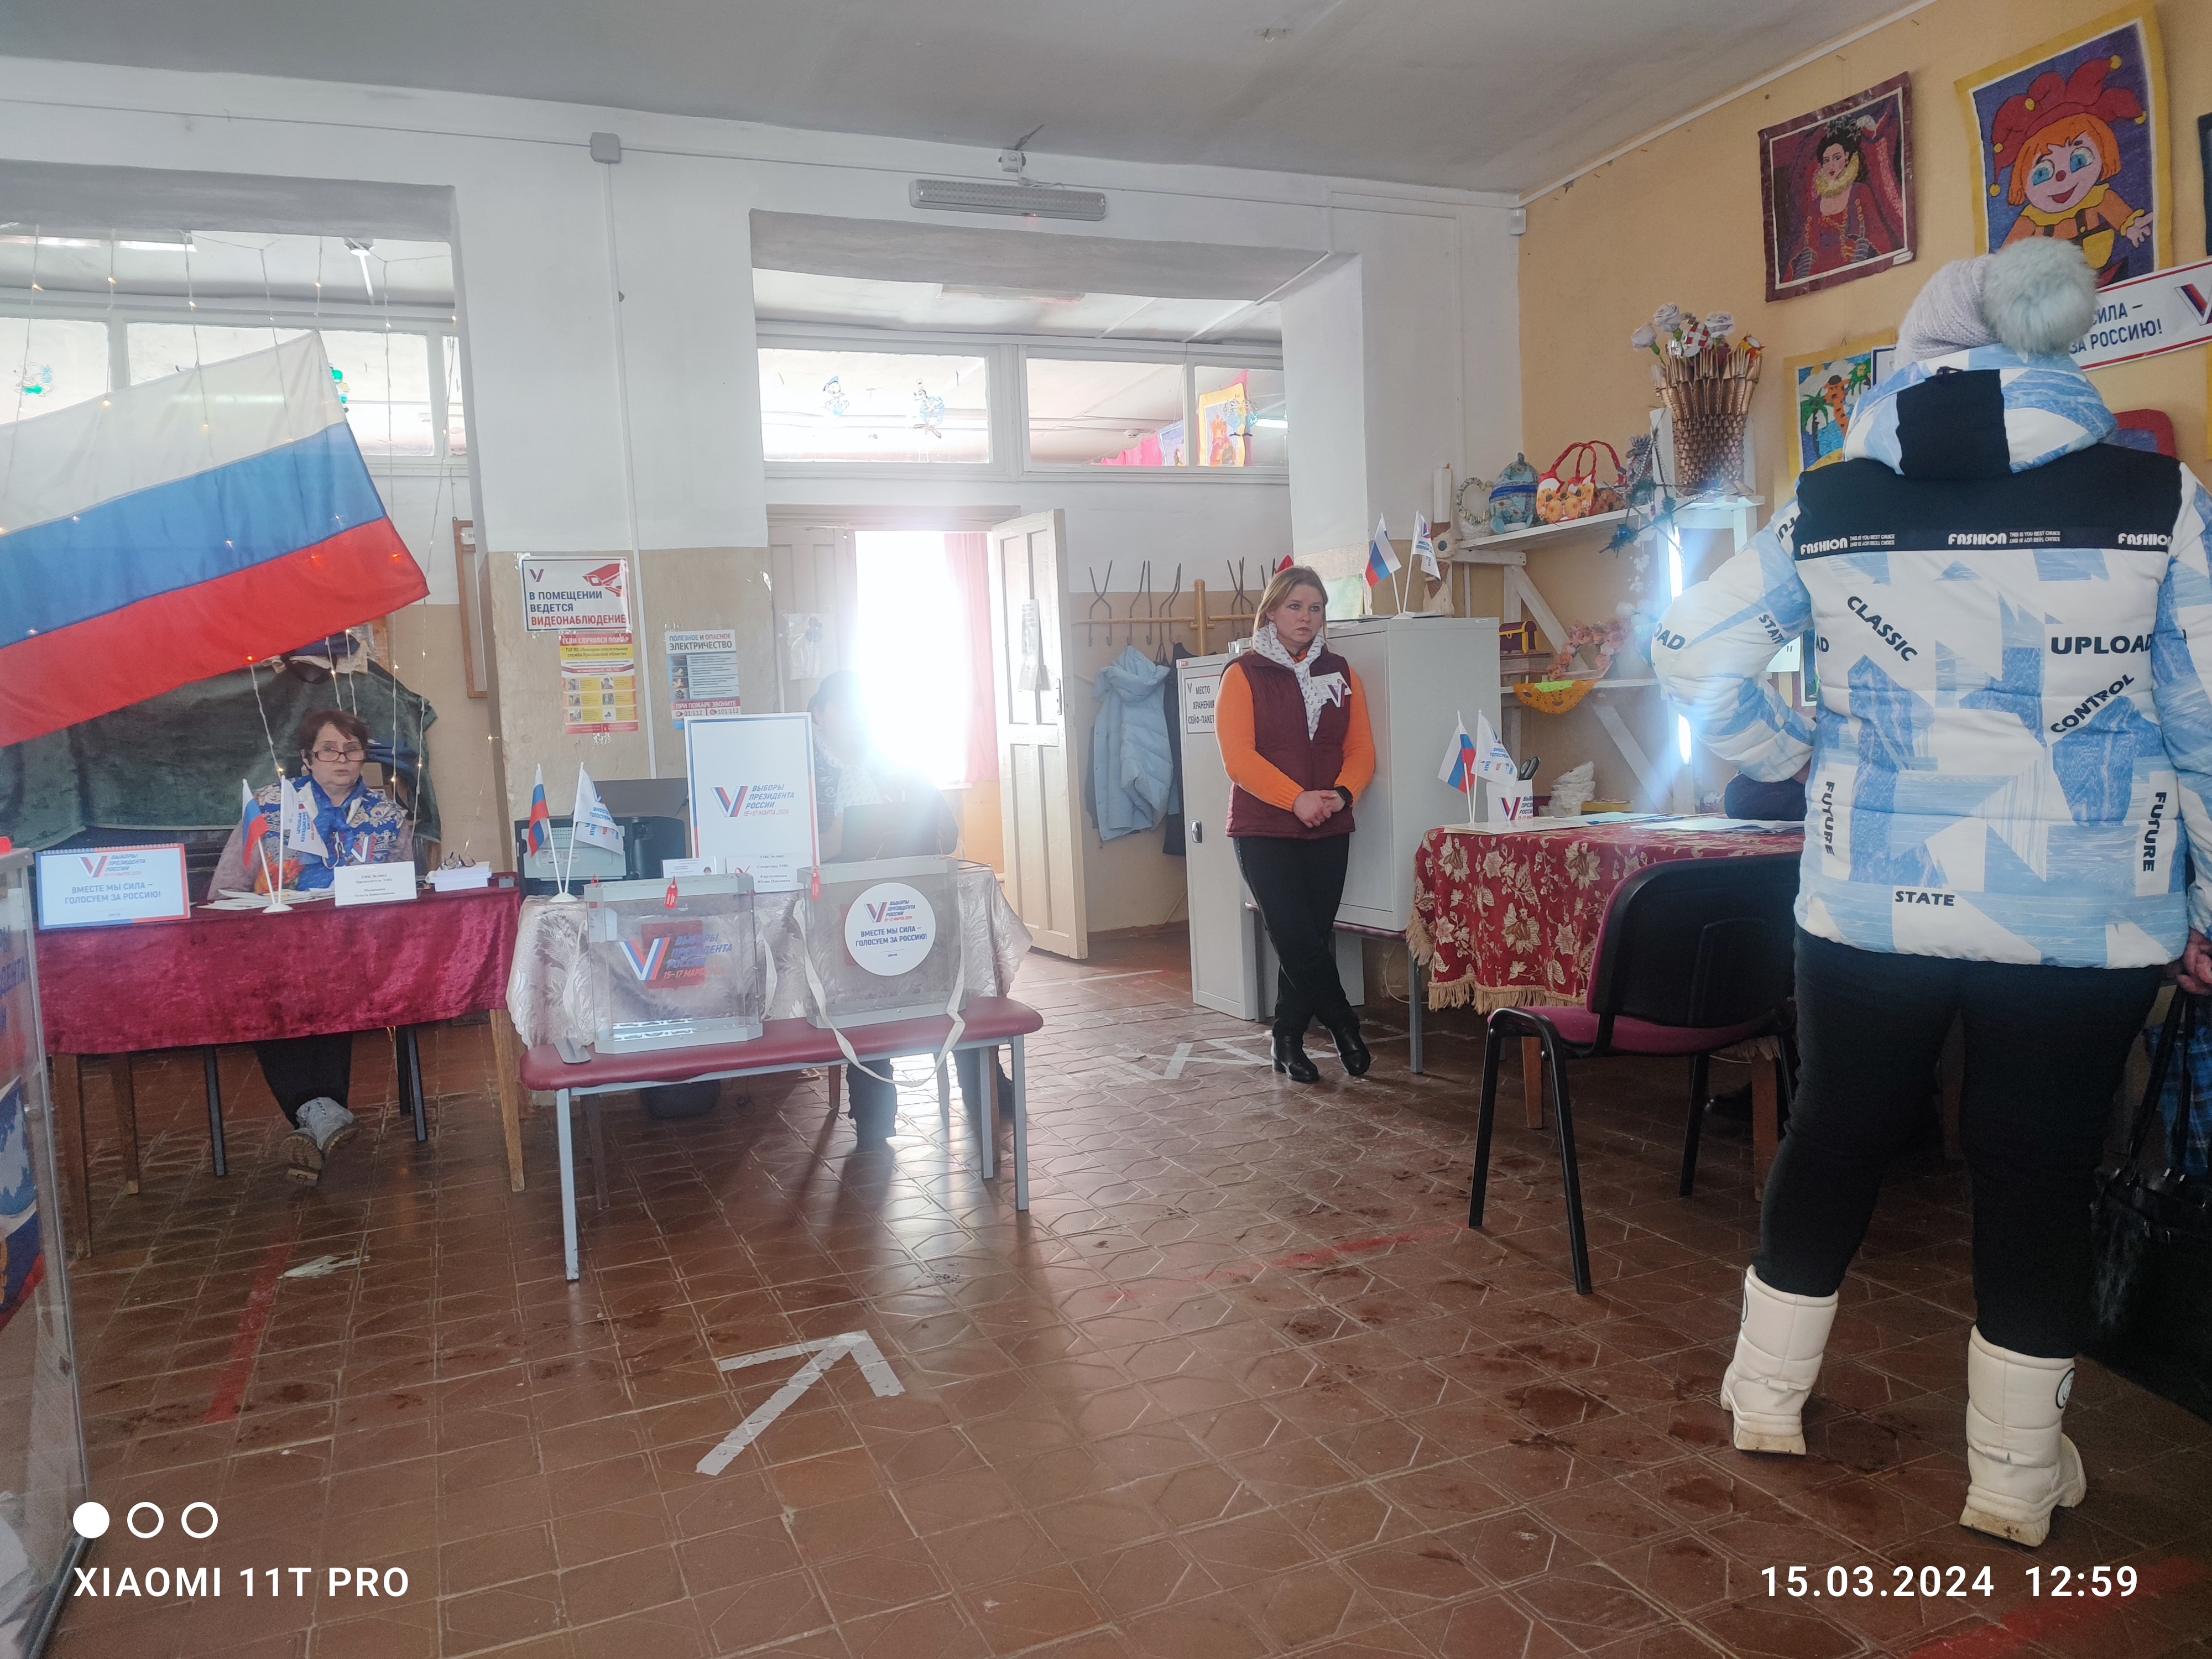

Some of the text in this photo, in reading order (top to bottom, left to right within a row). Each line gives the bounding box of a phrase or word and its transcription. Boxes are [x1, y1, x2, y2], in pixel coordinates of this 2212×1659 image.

[2093, 302, 2128, 326] ИЛА
[2090, 319, 2162, 349] РОССИЮ!
[1948, 533, 2007, 545] FASHION
[1800, 538, 1848, 555] FASHION
[539, 591, 602, 601] ПОМЕЩЕНИИ
[530, 603, 573, 614] ВЕДЕТСЯ
[531, 614, 626, 627] ВИДЕОНАБЛЮДЕНИЕ
[1847, 596, 1918, 662] CLASSIC
[669, 640, 732, 650] ЭЛЕКТРИЧЕСТВО
[1196, 685, 1211, 695] МЕСТО
[1192, 700, 1215, 709] ХРАНЕНИЯ
[2051, 674, 2135, 734] CONTROL
[748, 792, 794, 801] ПРЕЗИДЕНТА
[1822, 781, 1835, 856] FUTURE
[2143, 791, 2167, 872] FUTURE
[71, 885, 103, 894] ВМЕСТЕ
[123, 882, 145, 890] СИЛА
[65, 895, 108, 904] ГОЛОСУЕМ
[123, 891, 161, 900] РОССИЮ!
[1895, 891, 1955, 907] STATE
[860, 929, 885, 937] ВМЕСТЕ
[855, 937, 888, 947] ГОЛОСУЕМ
[899, 933, 927, 942] РОССИЮ!
